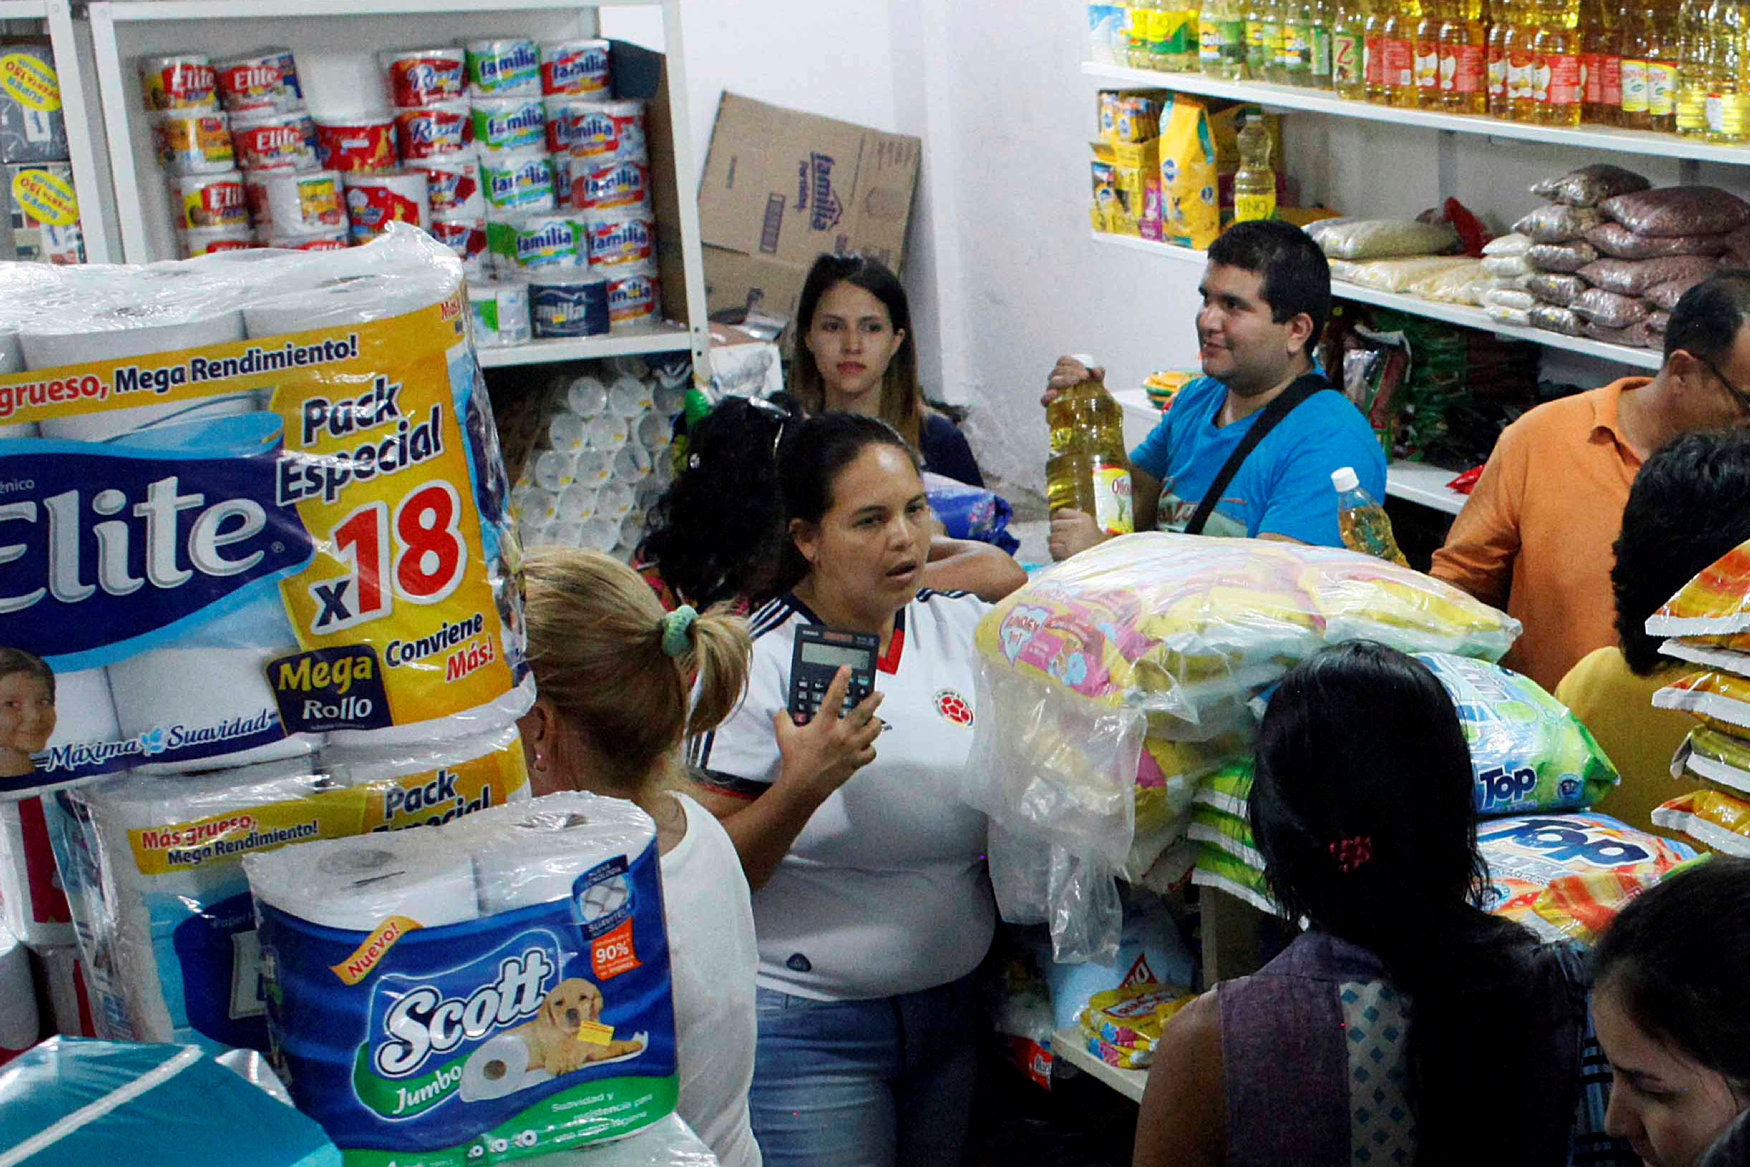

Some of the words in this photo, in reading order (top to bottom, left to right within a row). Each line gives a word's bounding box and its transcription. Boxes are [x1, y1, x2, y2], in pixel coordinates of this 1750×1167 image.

[234, 66, 279, 91] Elite
[256, 128, 301, 151] Elite
[517, 222, 573, 251] familia
[115, 360, 187, 394] Mega
[191, 333, 360, 383] Rendimiento!
[302, 376, 404, 447] Pack
[276, 403, 444, 506] Especial
[0, 475, 268, 613] Elite
[385, 612, 484, 669] Conviene
[446, 635, 495, 683] Más!
[277, 653, 374, 695] Mega
[302, 695, 374, 721] Rollo
[45, 738, 140, 772] Máxima
[166, 707, 271, 749] Suavidad
[384, 769, 459, 820] Pack
[1479, 763, 1537, 810] Top
[142, 826, 181, 850] Más
[166, 845, 212, 867] Mega
[213, 818, 319, 856] Rendimiento!
[347, 920, 401, 980] Nuevo!
[595, 940, 630, 964] 90%
[376, 947, 555, 1078] Scott
[392, 1063, 463, 1116] Jumbo
